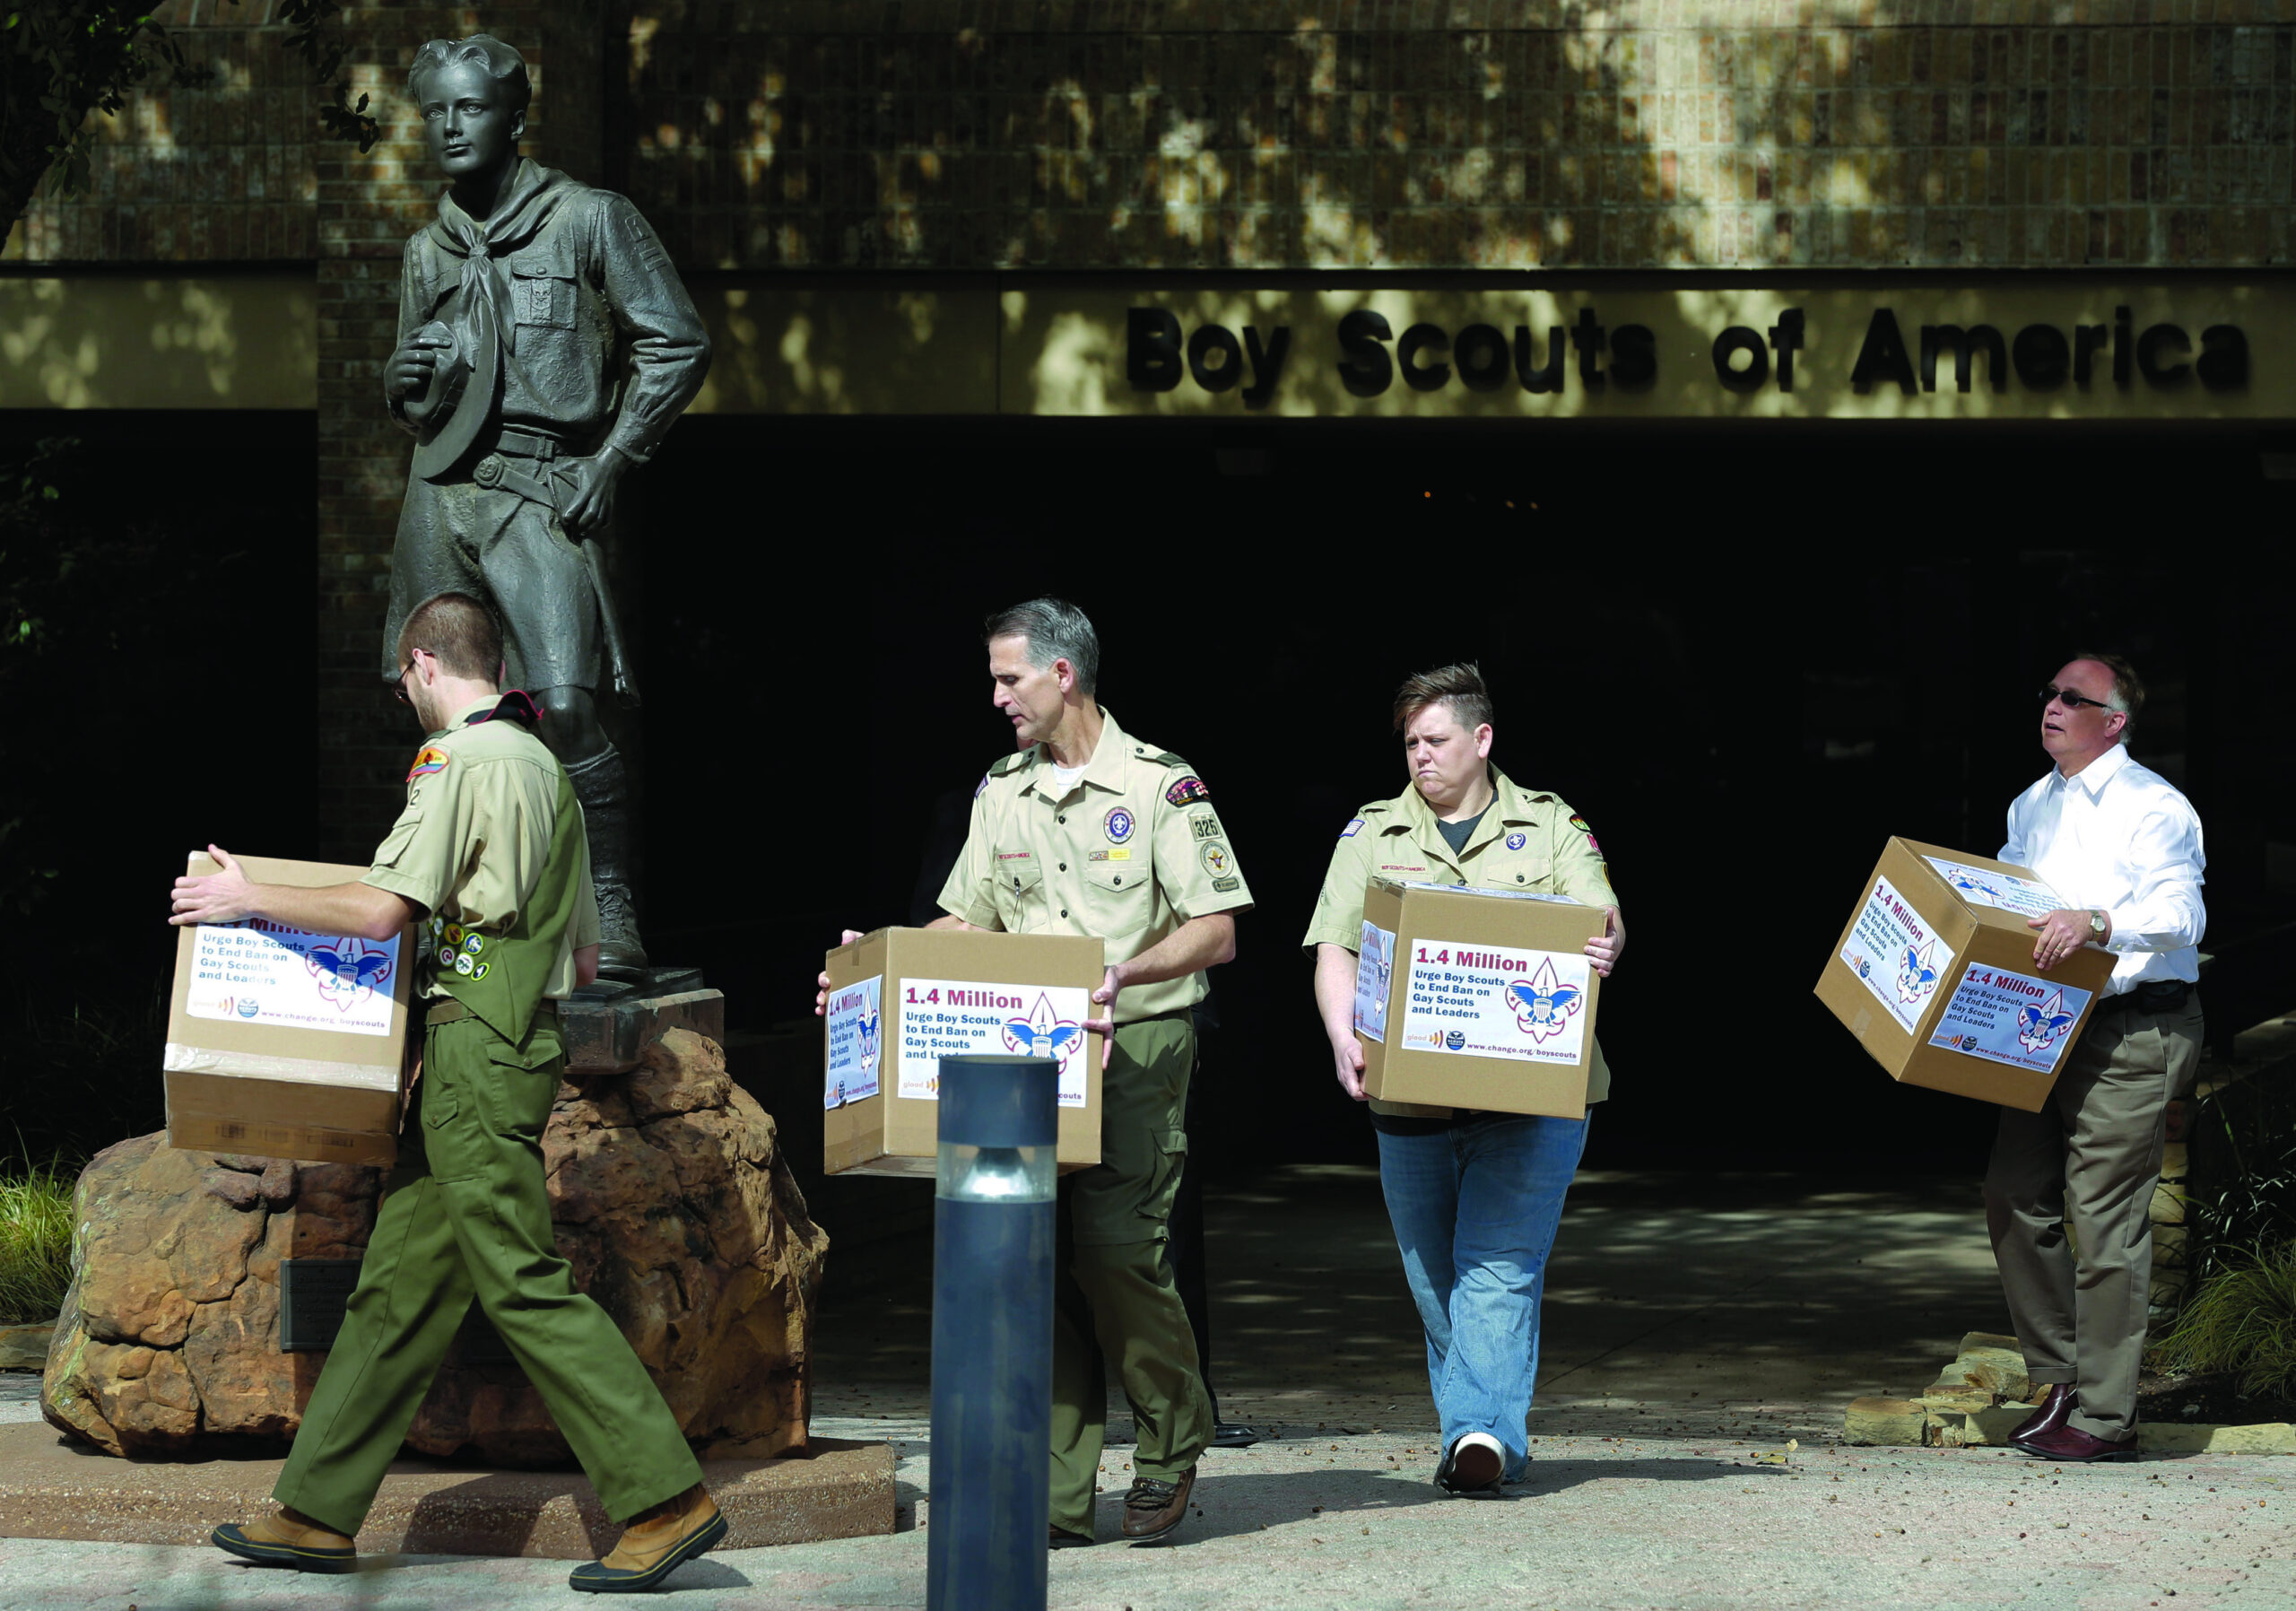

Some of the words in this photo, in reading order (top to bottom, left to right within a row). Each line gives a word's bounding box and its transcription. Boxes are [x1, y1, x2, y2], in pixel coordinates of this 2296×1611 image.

[1126, 307, 1292, 410] Boy
[1337, 308, 1657, 397] Scouts
[1712, 307, 1805, 393] of
[1850, 305, 2249, 395] America
[1195, 819, 1219, 838] 325
[1875, 884, 1893, 906] 1.4
[1891, 901, 1924, 942] Million
[1865, 909, 1871, 919] to
[1870, 916, 1881, 928] End
[1881, 925, 1891, 938] Ban
[1890, 937, 1898, 947] on
[1869, 901, 1882, 915] Urge
[1881, 913, 1891, 927] Boy
[1890, 923, 1908, 945] Scouts
[204, 933, 232, 945] Urge
[236, 936, 258, 948] Boy
[262, 938, 305, 952] Scouts
[1860, 918, 1870, 932] Gay
[1870, 927, 1887, 950] Scouts
[202, 945, 214, 954] to
[218, 946, 241, 957] End
[245, 949, 269, 960] Ban
[272, 954, 288, 962] on
[1856, 927, 1866, 940] and
[1866, 937, 1885, 962] Leaders
[200, 957, 223, 969] Gay
[1416, 947, 1449, 964] 1.4
[1456, 951, 1527, 972] Million
[198, 971, 222, 980] and
[1415, 970, 1441, 981] Urge
[1444, 972, 1465, 983] Boy
[1467, 974, 1505, 986] Scouts
[1966, 969, 1992, 985] 1.4
[1993, 975, 2045, 998] Million
[906, 987, 940, 1005] 1.4
[947, 989, 1022, 1009] Million
[1413, 981, 1425, 990] to
[1429, 983, 1449, 992] End
[1452, 985, 1474, 995] Ban
[1476, 988, 1490, 997] on
[1960, 985, 1979, 996] Urge
[1979, 990, 1996, 1000] Boy
[1996, 994, 2023, 1006] Scouts
[830, 997, 840, 1016] 1.4
[841, 991, 863, 1012] Million
[1413, 993, 1434, 1004] Gay
[1436, 995, 1474, 1006] Scouts
[1955, 994, 1964, 1002] to
[1965, 997, 1981, 1006] End
[1982, 1000, 1997, 1010] Ban
[1998, 1006, 2009, 1014] on
[906, 1011, 933, 1023] Urge
[936, 1013, 958, 1024] Boy
[961, 1014, 1002, 1025] Scouts
[1412, 1006, 1432, 1014] and
[1435, 1006, 1480, 1019] Leaders
[1946, 1012, 1962, 1022] and
[1962, 1015, 1996, 1030] Leaders
[1951, 1003, 1967, 1014] Gay
[1967, 1006, 1995, 1020] Scouts
[905, 1024, 918, 1033] to
[921, 1025, 943, 1035] End
[945, 1026, 968, 1036] Ban
[971, 1029, 986, 1037] on
[905, 1036, 927, 1048] Gay
[930, 1038, 970, 1049] Scouts
[1466, 1042, 1577, 1059] www.change.org/boyscouts
[905, 1050, 926, 1059] and
[1975, 1046, 2052, 1069] www.change.org/boyscouts
